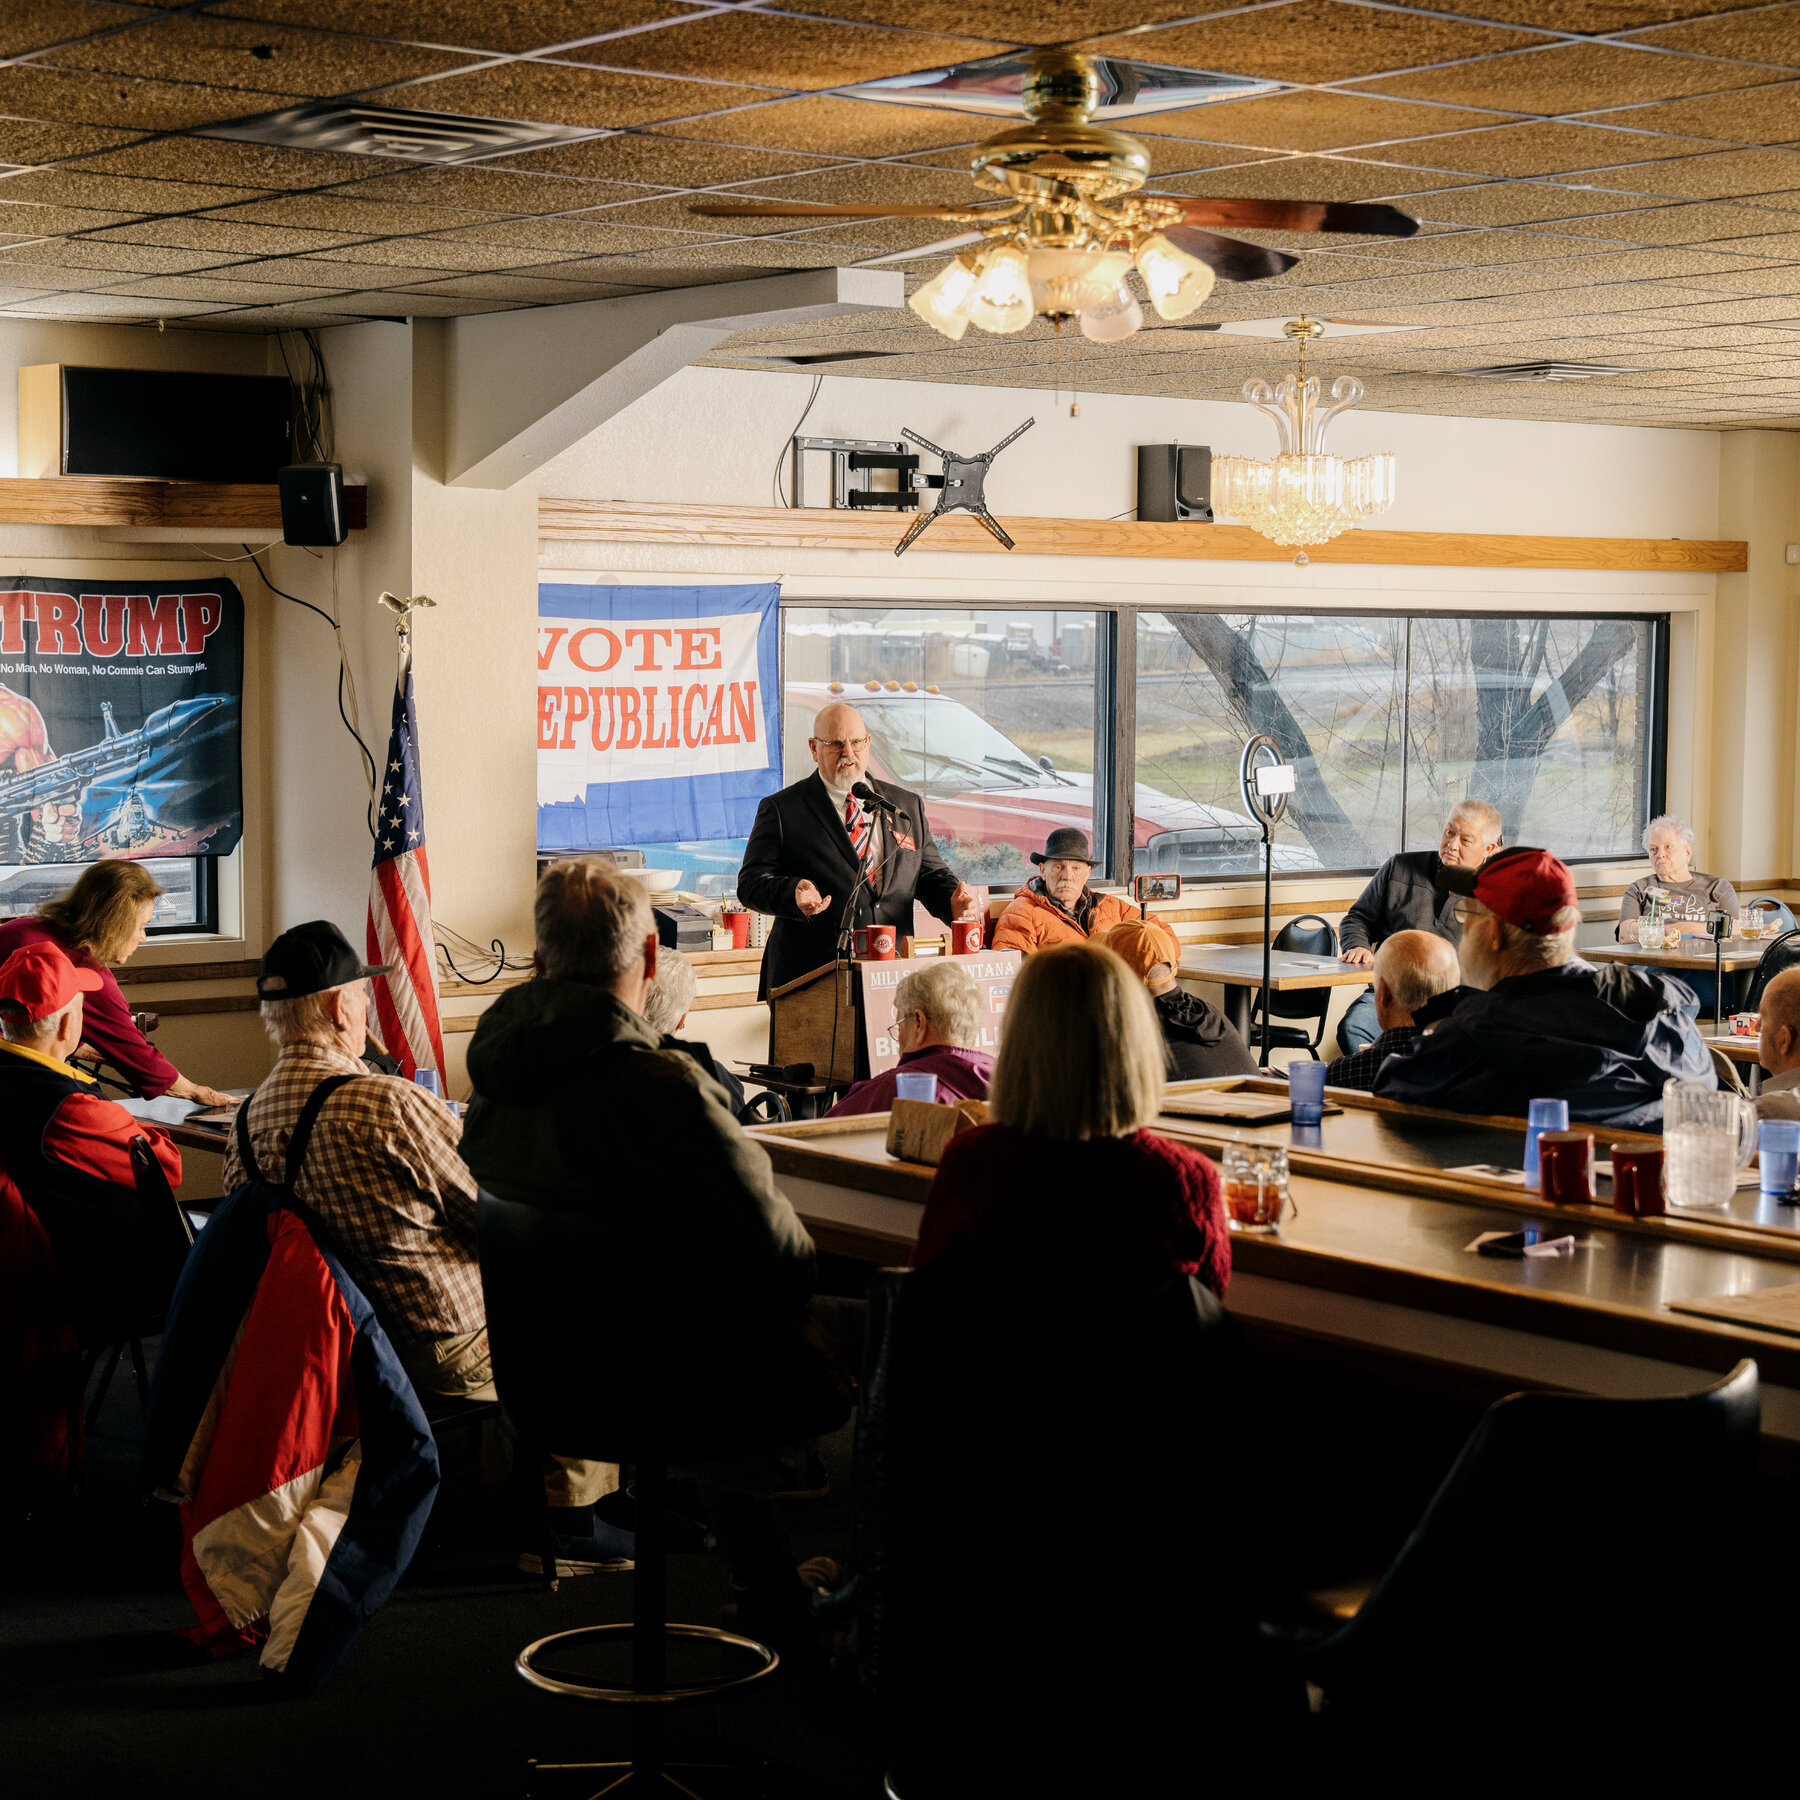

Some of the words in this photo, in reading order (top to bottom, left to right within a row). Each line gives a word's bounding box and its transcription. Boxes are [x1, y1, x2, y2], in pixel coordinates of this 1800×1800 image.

[0, 589, 222, 657] TRUMP
[0, 663, 14, 674] No
[15, 663, 38, 674] Man,
[39, 663, 53, 674] No
[54, 664, 90, 676] Woman,
[92, 665, 106, 675] No
[107, 665, 144, 675] Commie
[146, 665, 166, 675] Can
[167, 664, 194, 675] Stump
[537, 627, 722, 672] VOTE
[537, 681, 757, 751] EPUBLICAN
[966, 962, 1015, 977] NTANA
